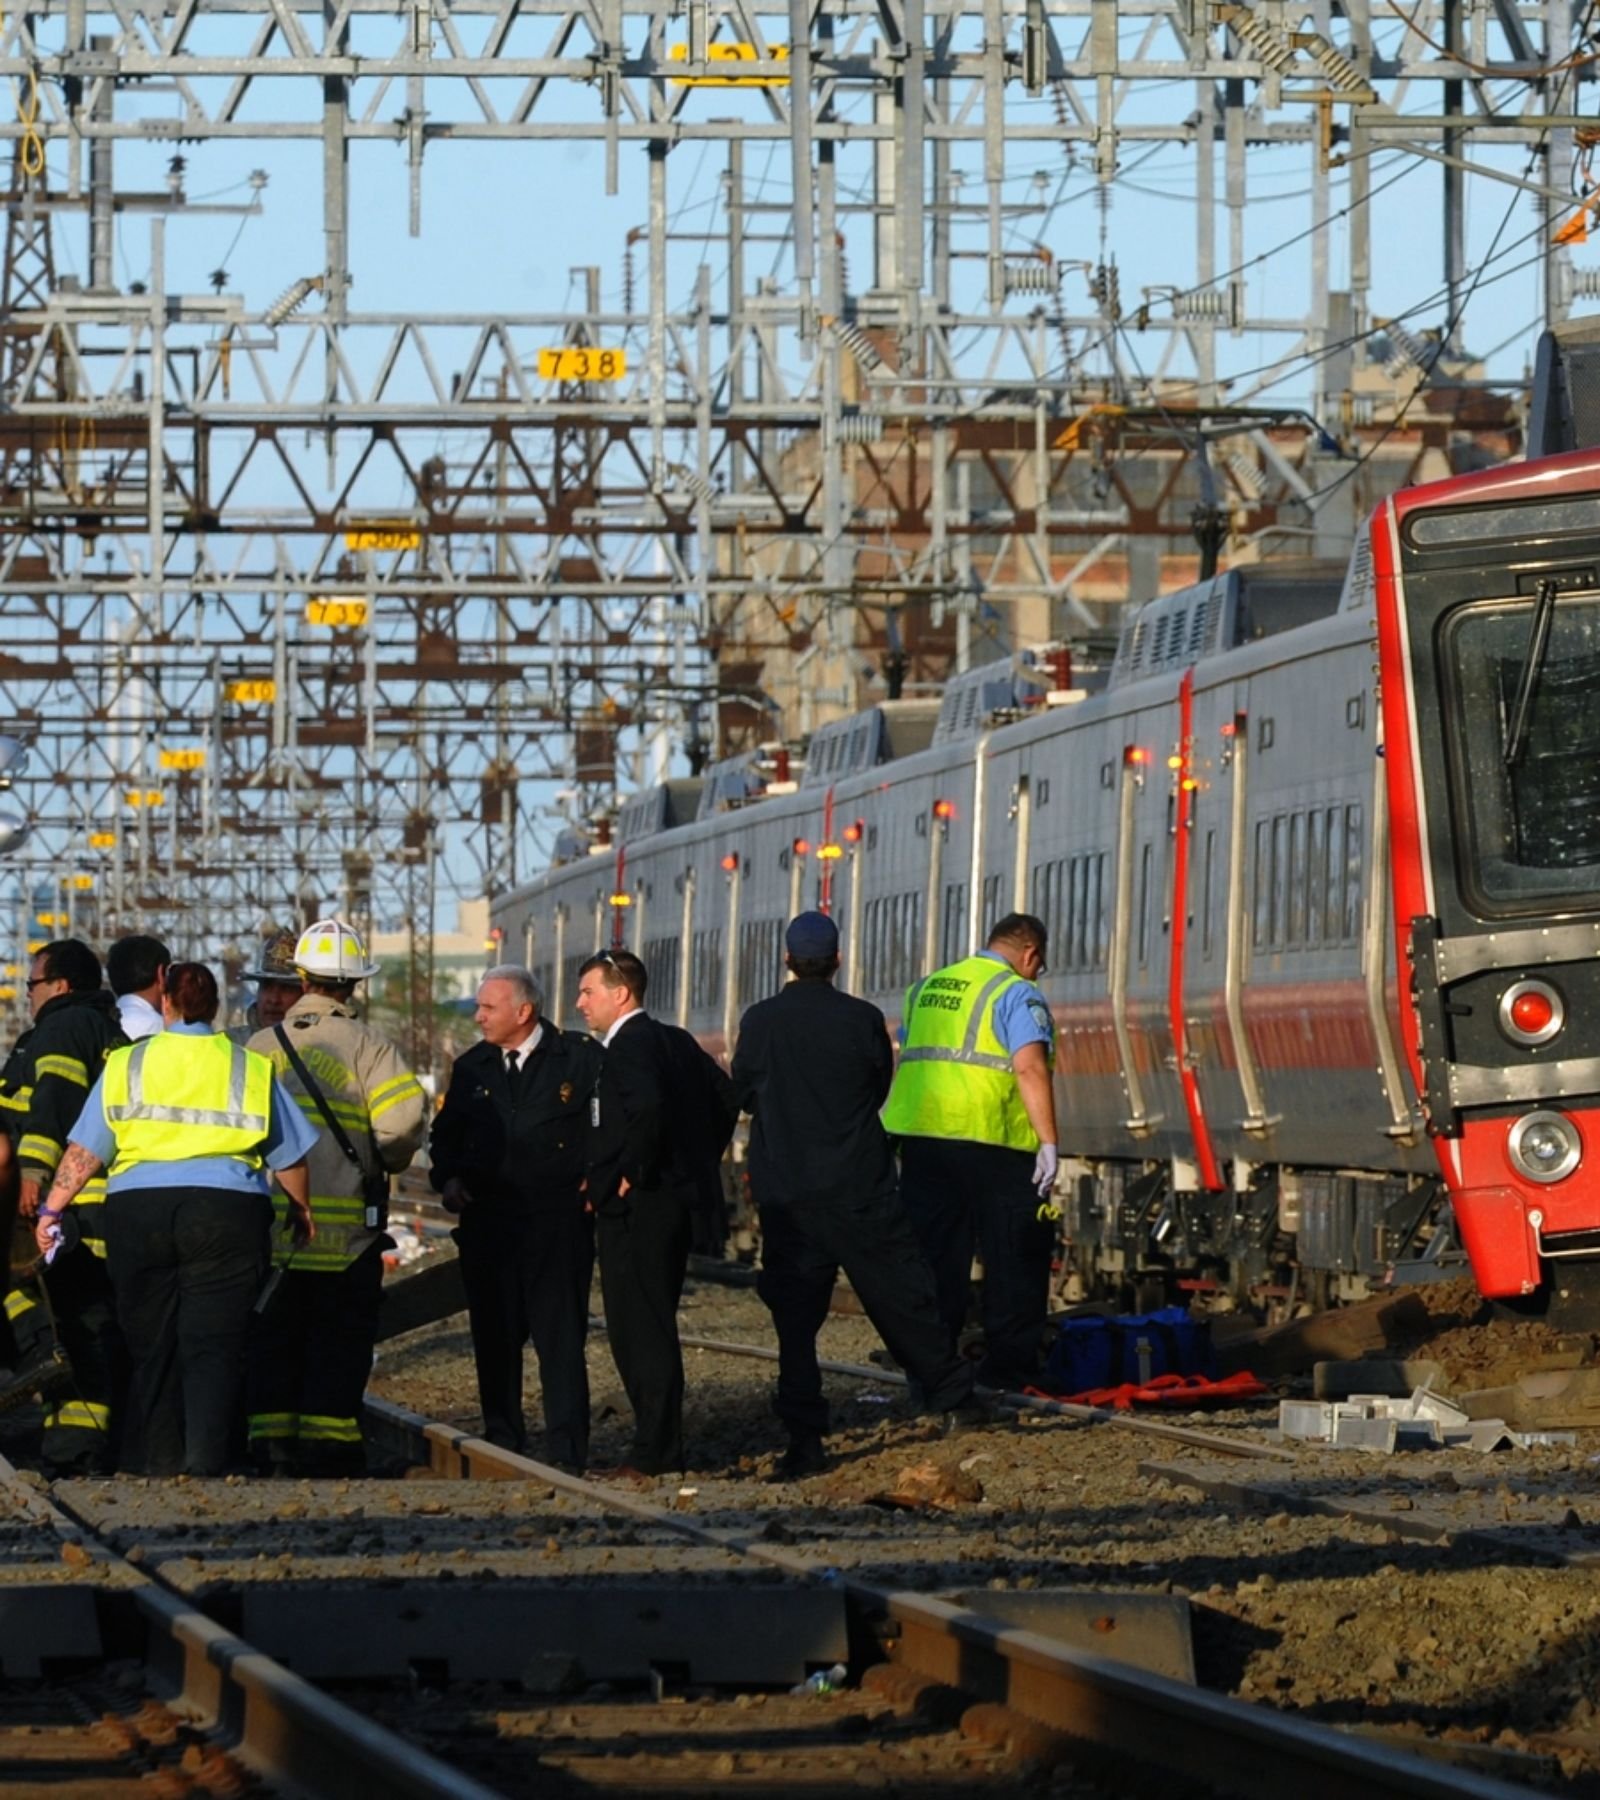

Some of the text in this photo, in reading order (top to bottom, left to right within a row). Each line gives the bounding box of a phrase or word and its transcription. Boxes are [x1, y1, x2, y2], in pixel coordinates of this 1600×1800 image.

[547, 351, 615, 377] 738
[314, 602, 367, 622] 739
[918, 994, 962, 1010] SERVICES
